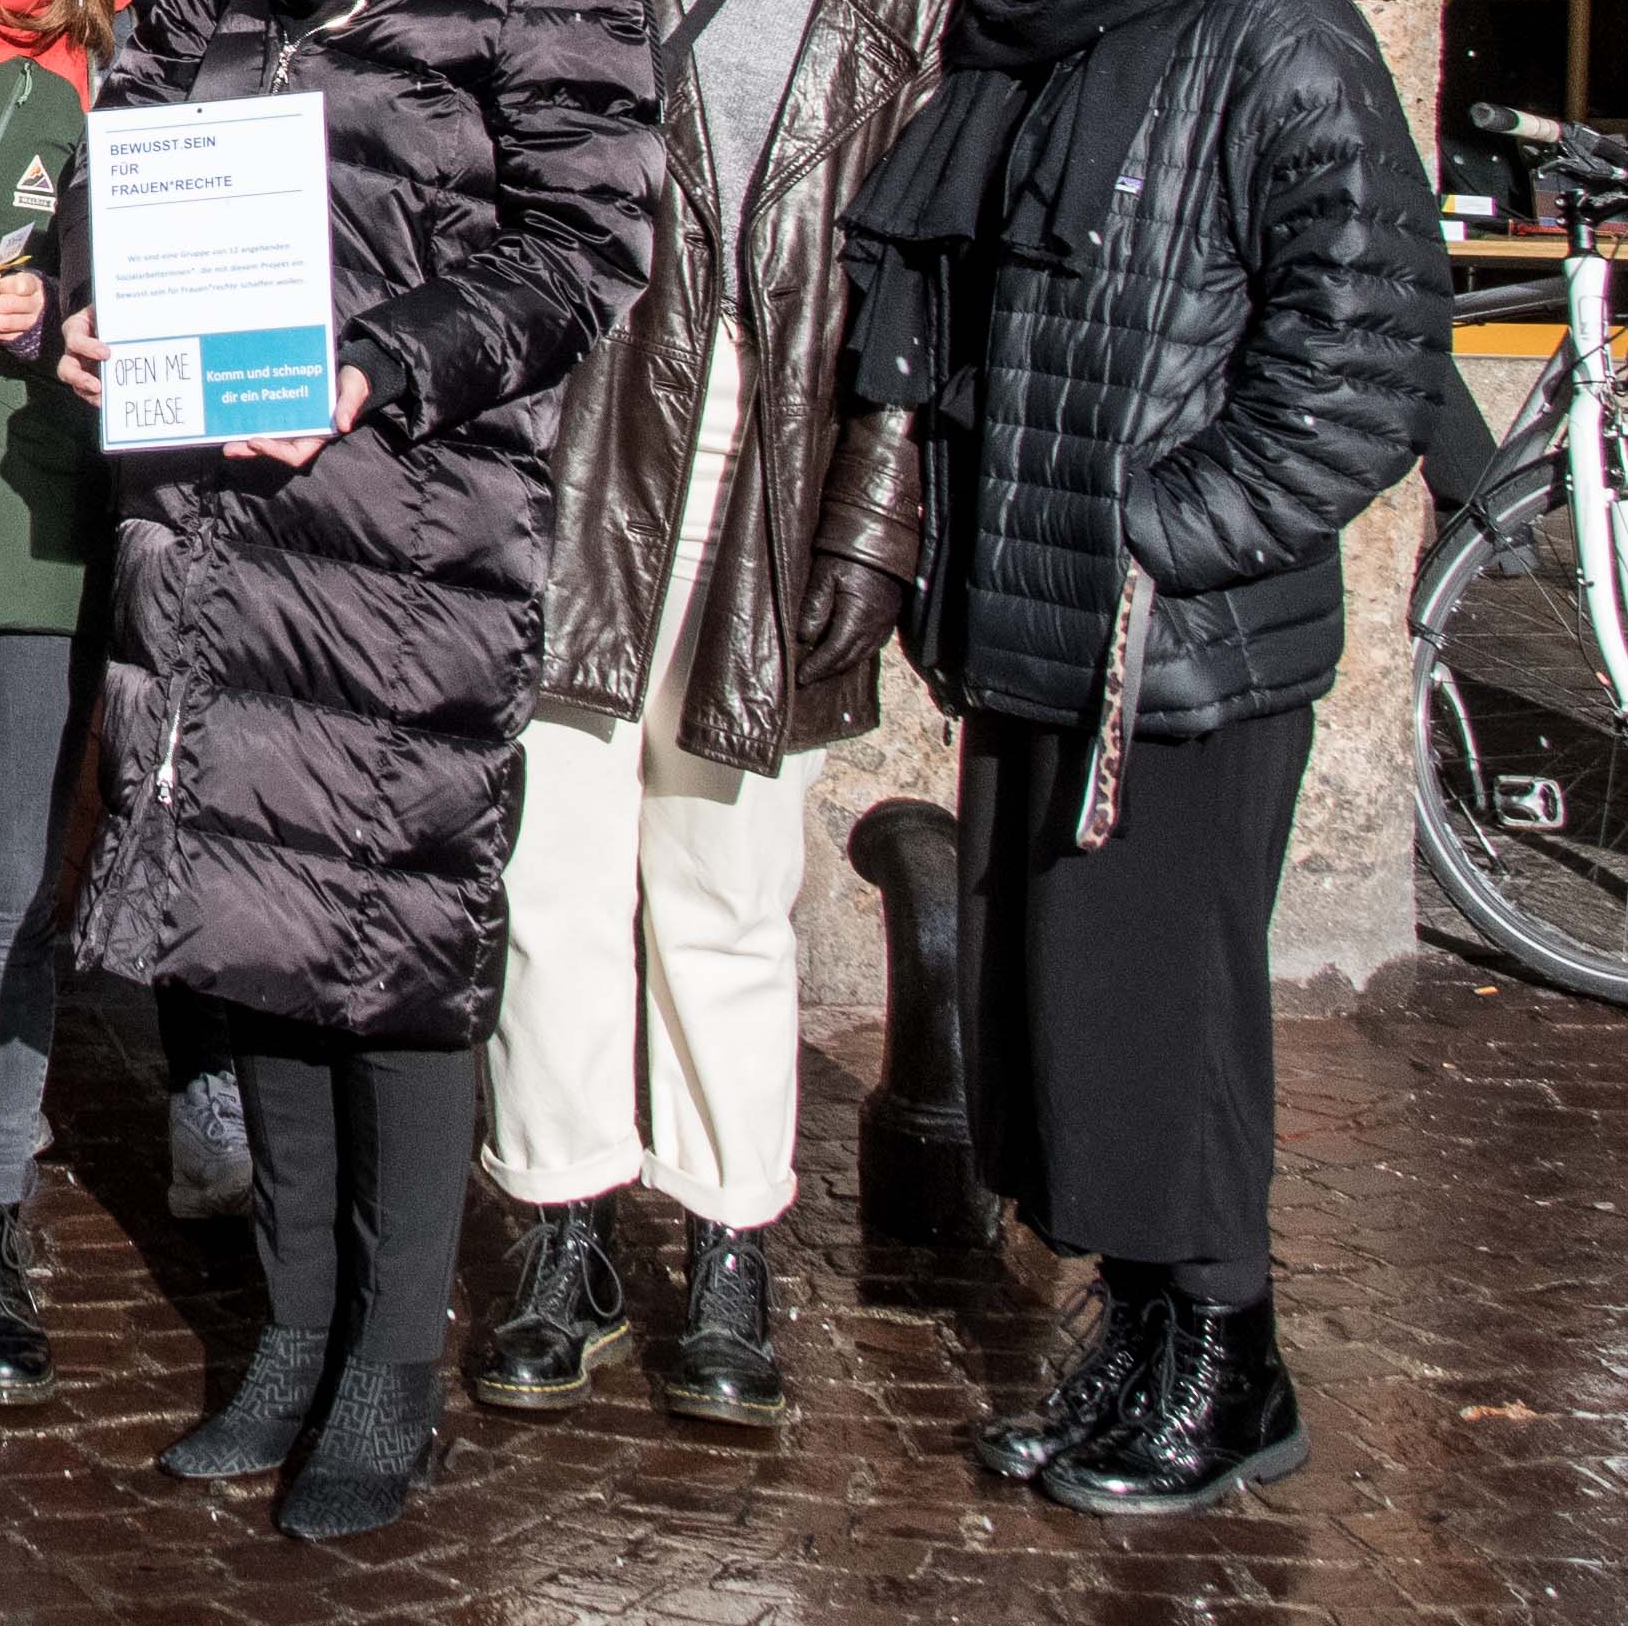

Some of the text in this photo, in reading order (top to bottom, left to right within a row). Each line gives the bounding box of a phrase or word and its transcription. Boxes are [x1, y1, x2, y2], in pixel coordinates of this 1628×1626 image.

[110, 161, 140, 177] FÜR
[115, 352, 323, 387] OPEN ME Komm und schnapp
[124, 396, 185, 429] PLEASE
[221, 389, 239, 405] dir
[240, 387, 260, 402] ein
